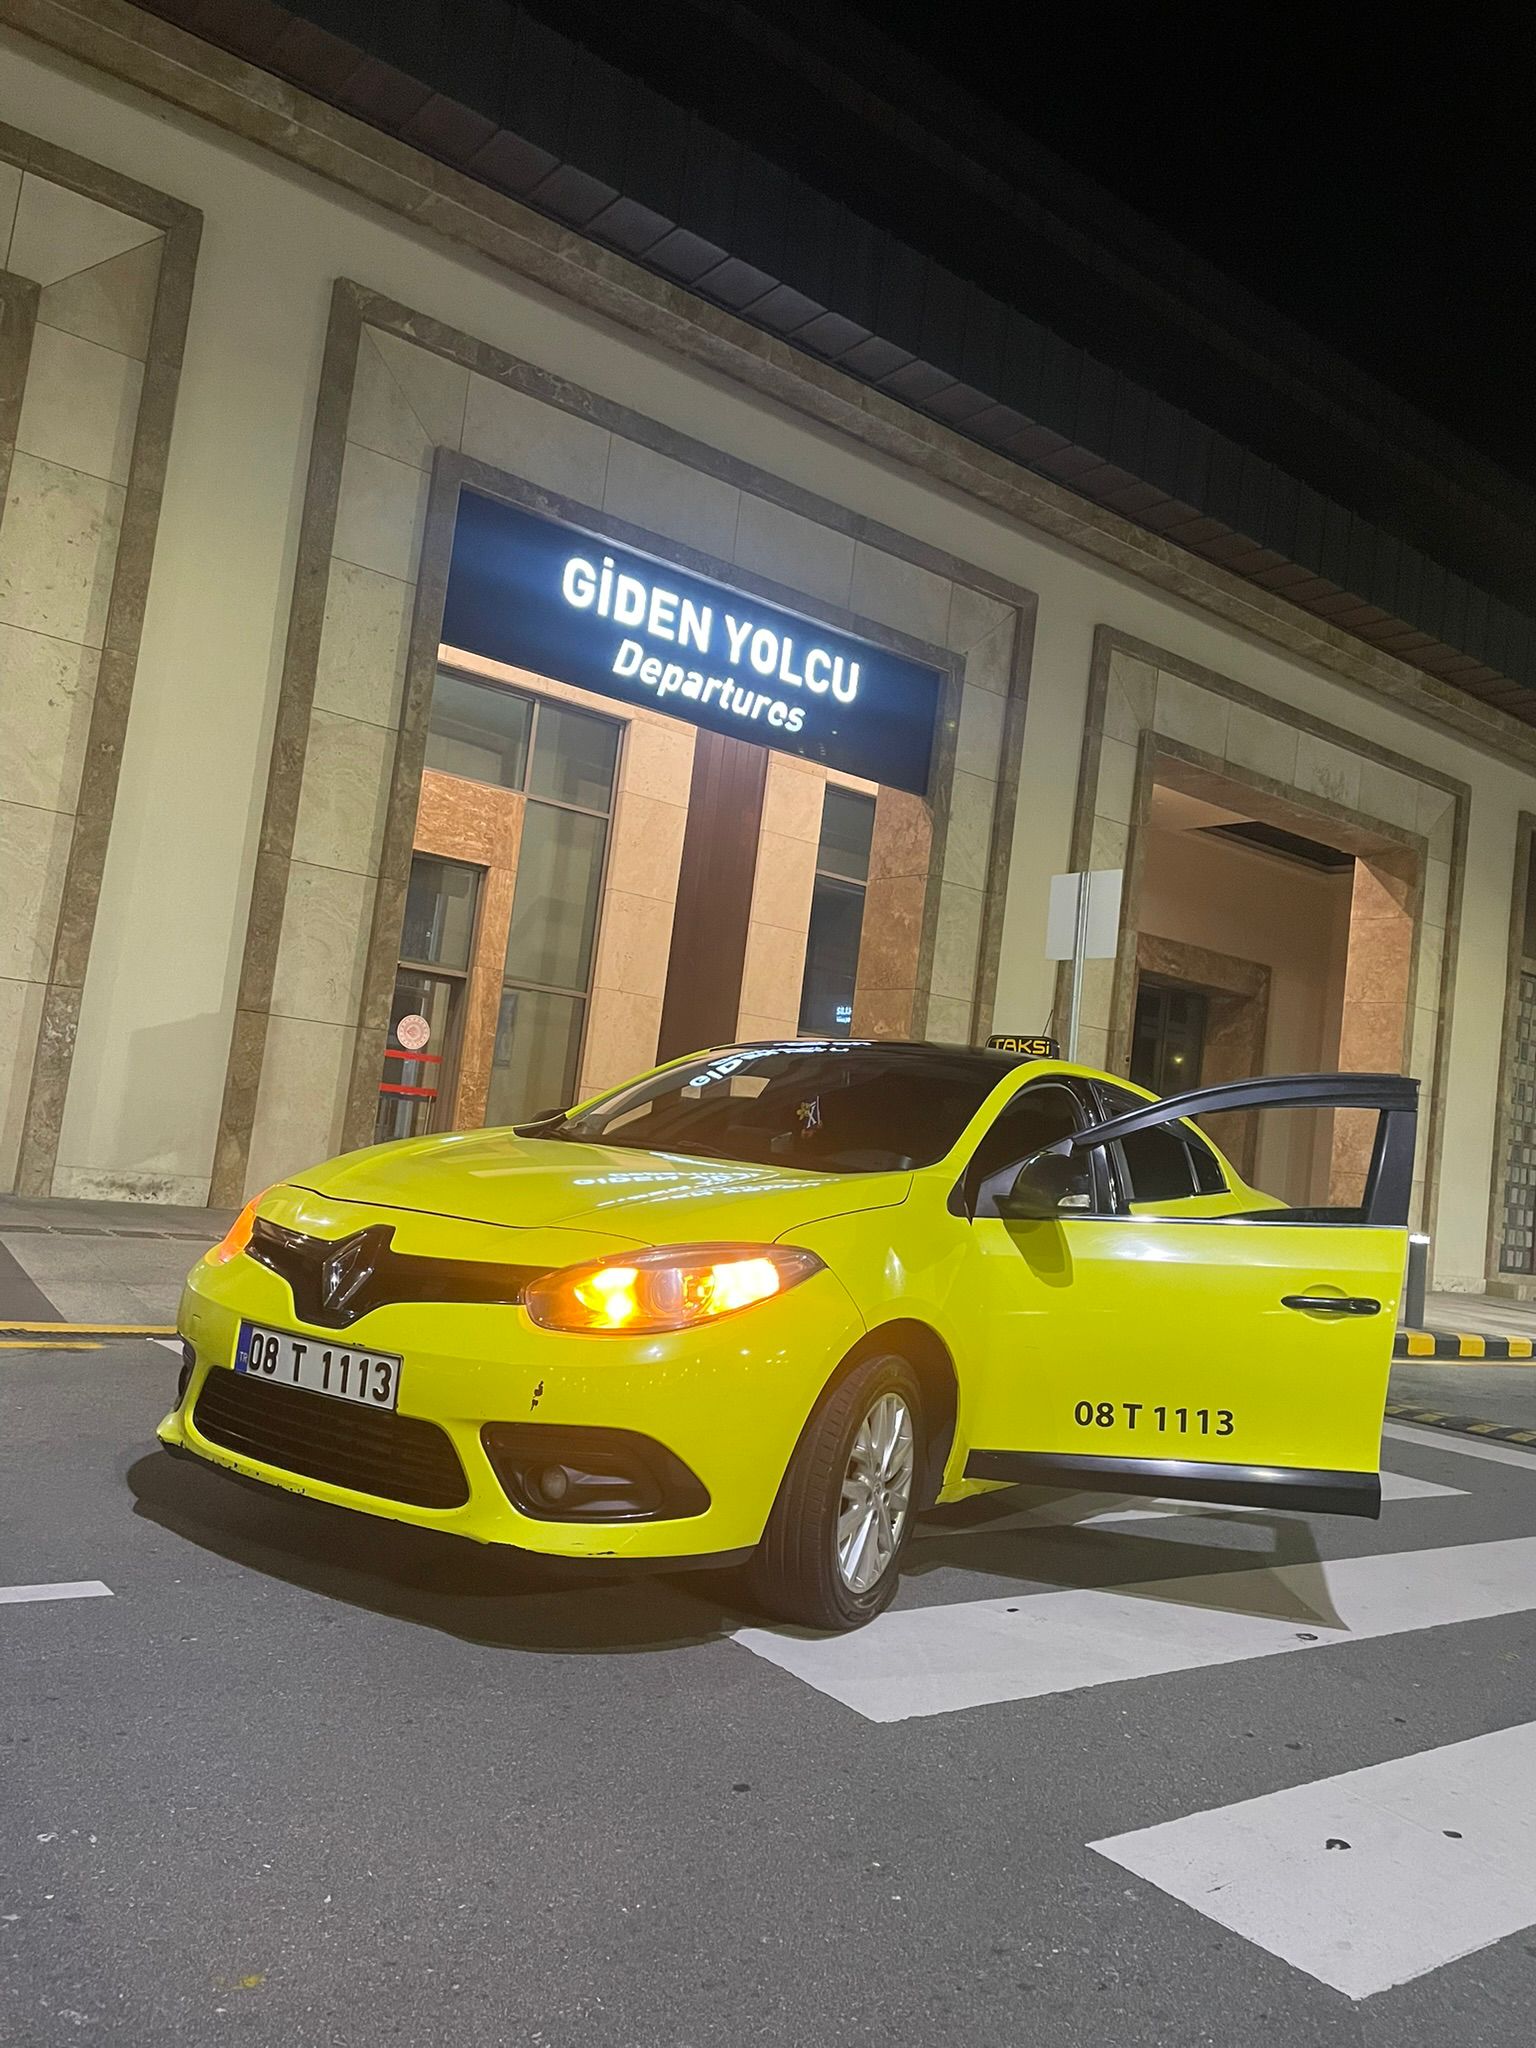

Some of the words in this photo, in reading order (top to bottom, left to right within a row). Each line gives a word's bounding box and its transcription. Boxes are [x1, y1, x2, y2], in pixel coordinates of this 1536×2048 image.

[561, 555, 713, 654] GİDEN
[724, 612, 860, 703] YOLCU
[611, 638, 807, 732] Departures
[249, 1332, 280, 1375] 08
[291, 1342, 307, 1382] T
[322, 1350, 392, 1402] 1113
[1074, 1400, 1115, 1428] 08
[1122, 1403, 1143, 1430] T
[1154, 1406, 1235, 1436] 1113
